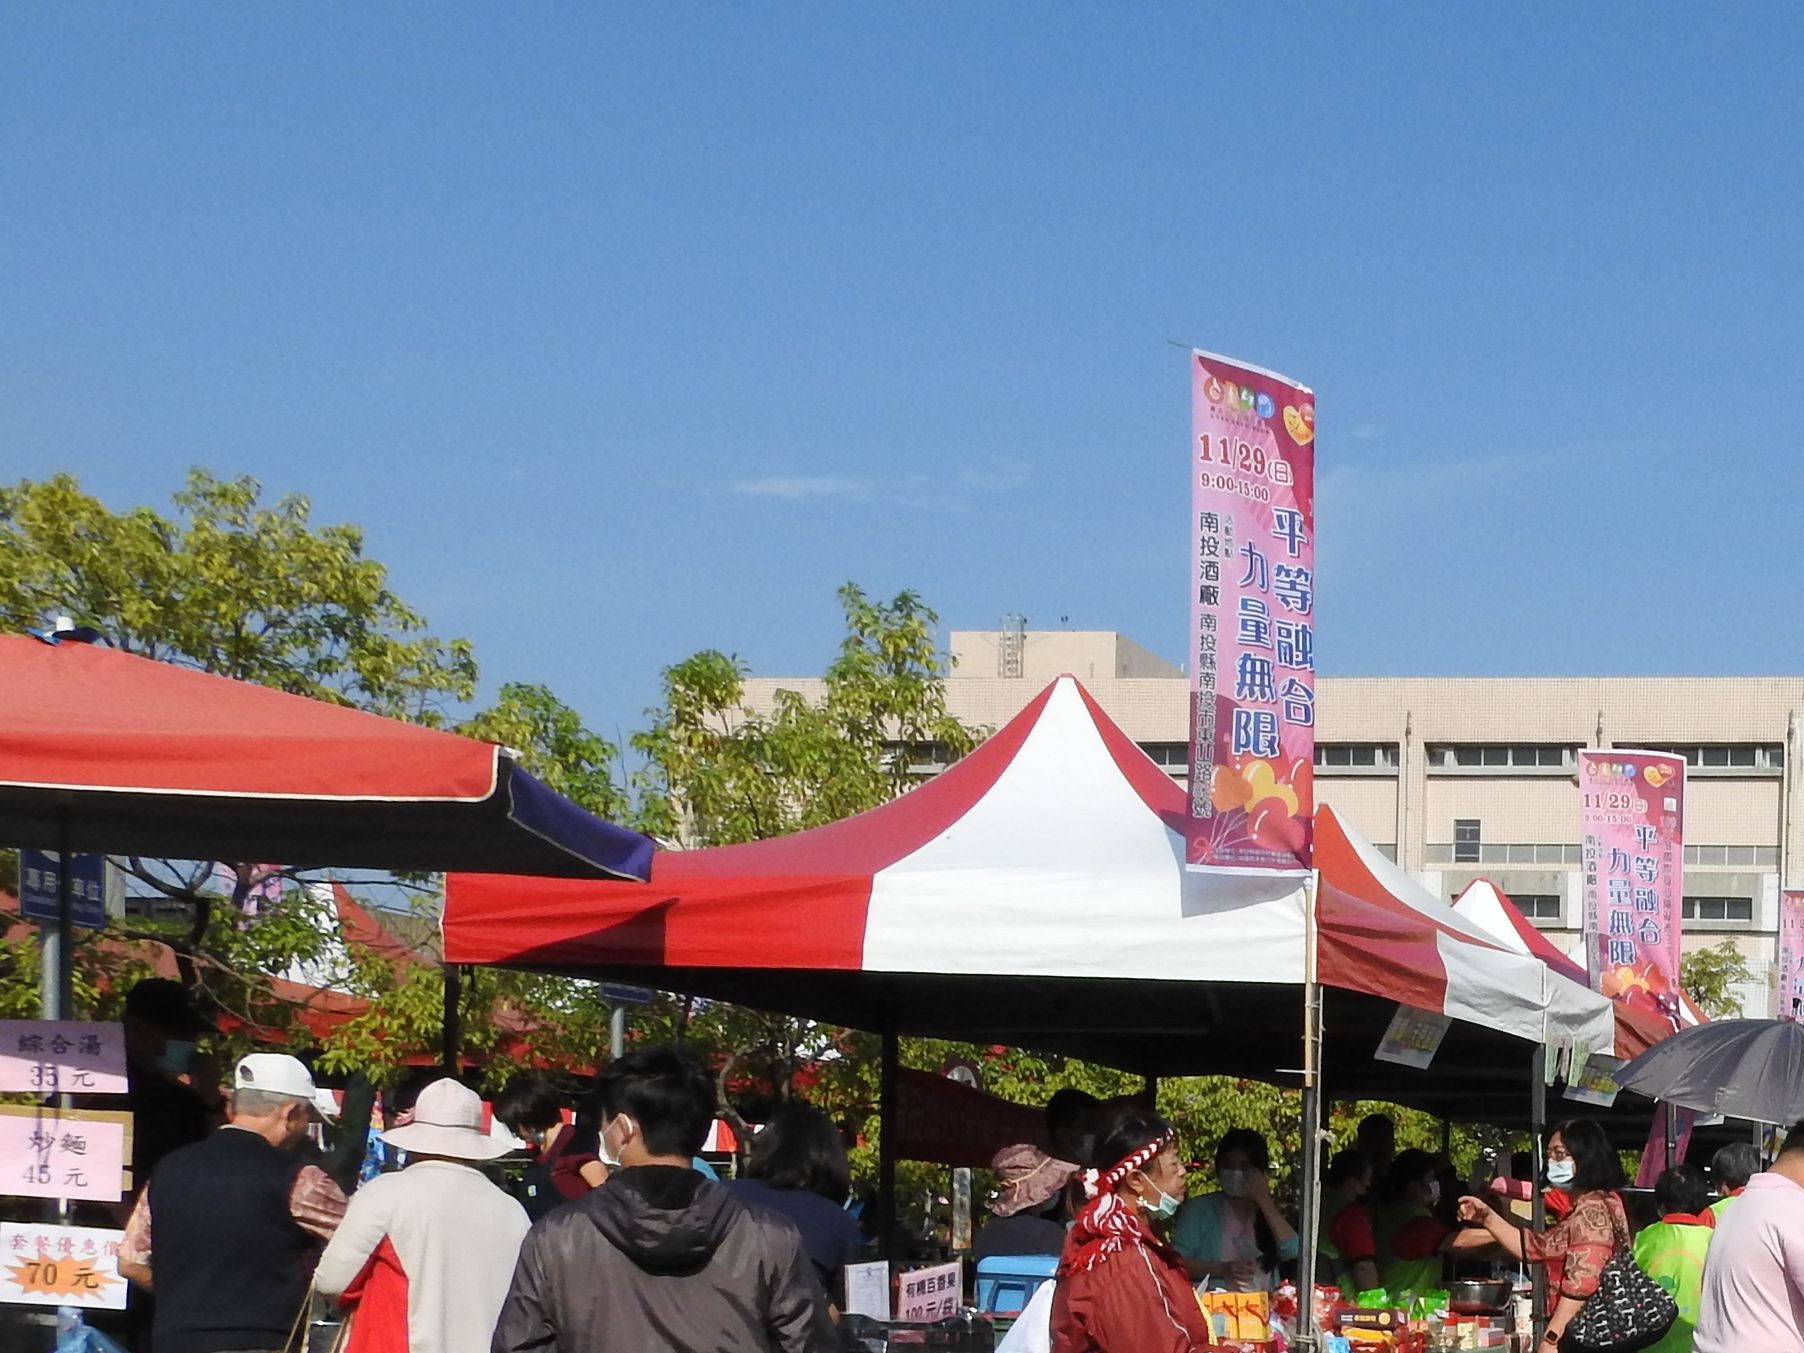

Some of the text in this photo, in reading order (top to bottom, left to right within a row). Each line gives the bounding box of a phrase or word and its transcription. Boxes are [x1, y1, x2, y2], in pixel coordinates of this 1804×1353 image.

[1201, 472, 1269, 502] 9:00-15:00
[1198, 511, 1220, 607] 南投酒廠
[1271, 508, 1315, 725] 平等融合
[1233, 540, 1280, 758] 力量無限
[1607, 847, 1636, 965] 力量無限
[1634, 825, 1661, 944] 平等融合
[18, 1033, 103, 1056] 綜合湯
[30, 1065, 96, 1088] 35 元
[22, 1163, 89, 1188] 45 元
[27, 1261, 99, 1289] 70 元
